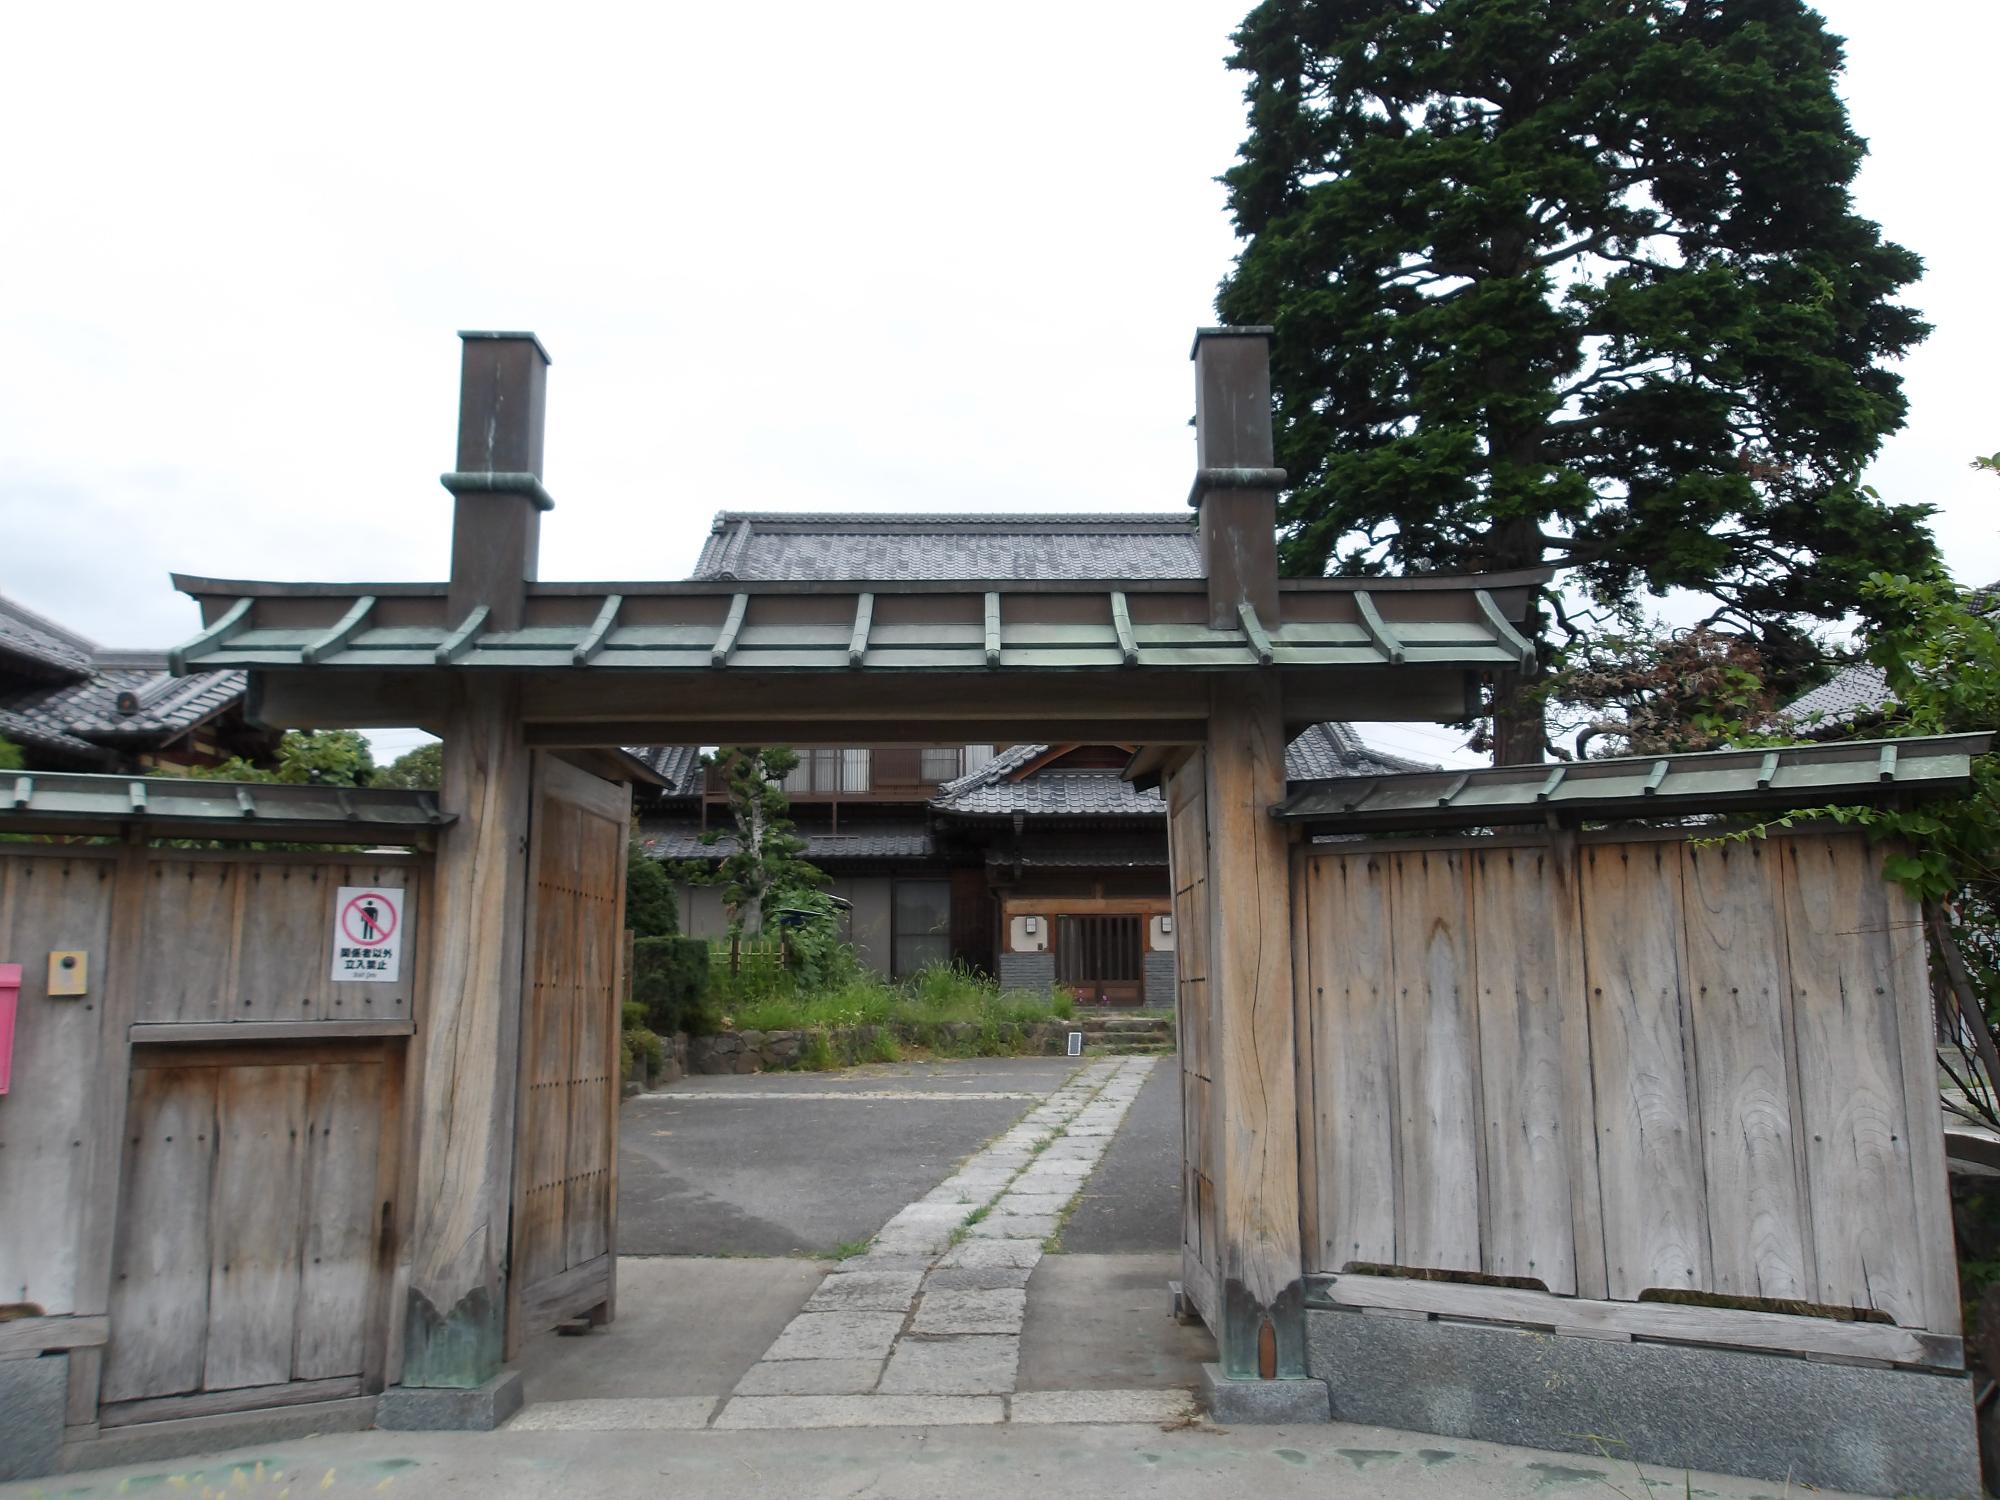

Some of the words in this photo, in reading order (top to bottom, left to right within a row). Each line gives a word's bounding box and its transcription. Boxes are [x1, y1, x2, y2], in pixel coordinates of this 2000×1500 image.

[340, 947, 392, 958] 関係者以外
[344, 959, 387, 970] 立入禁止
